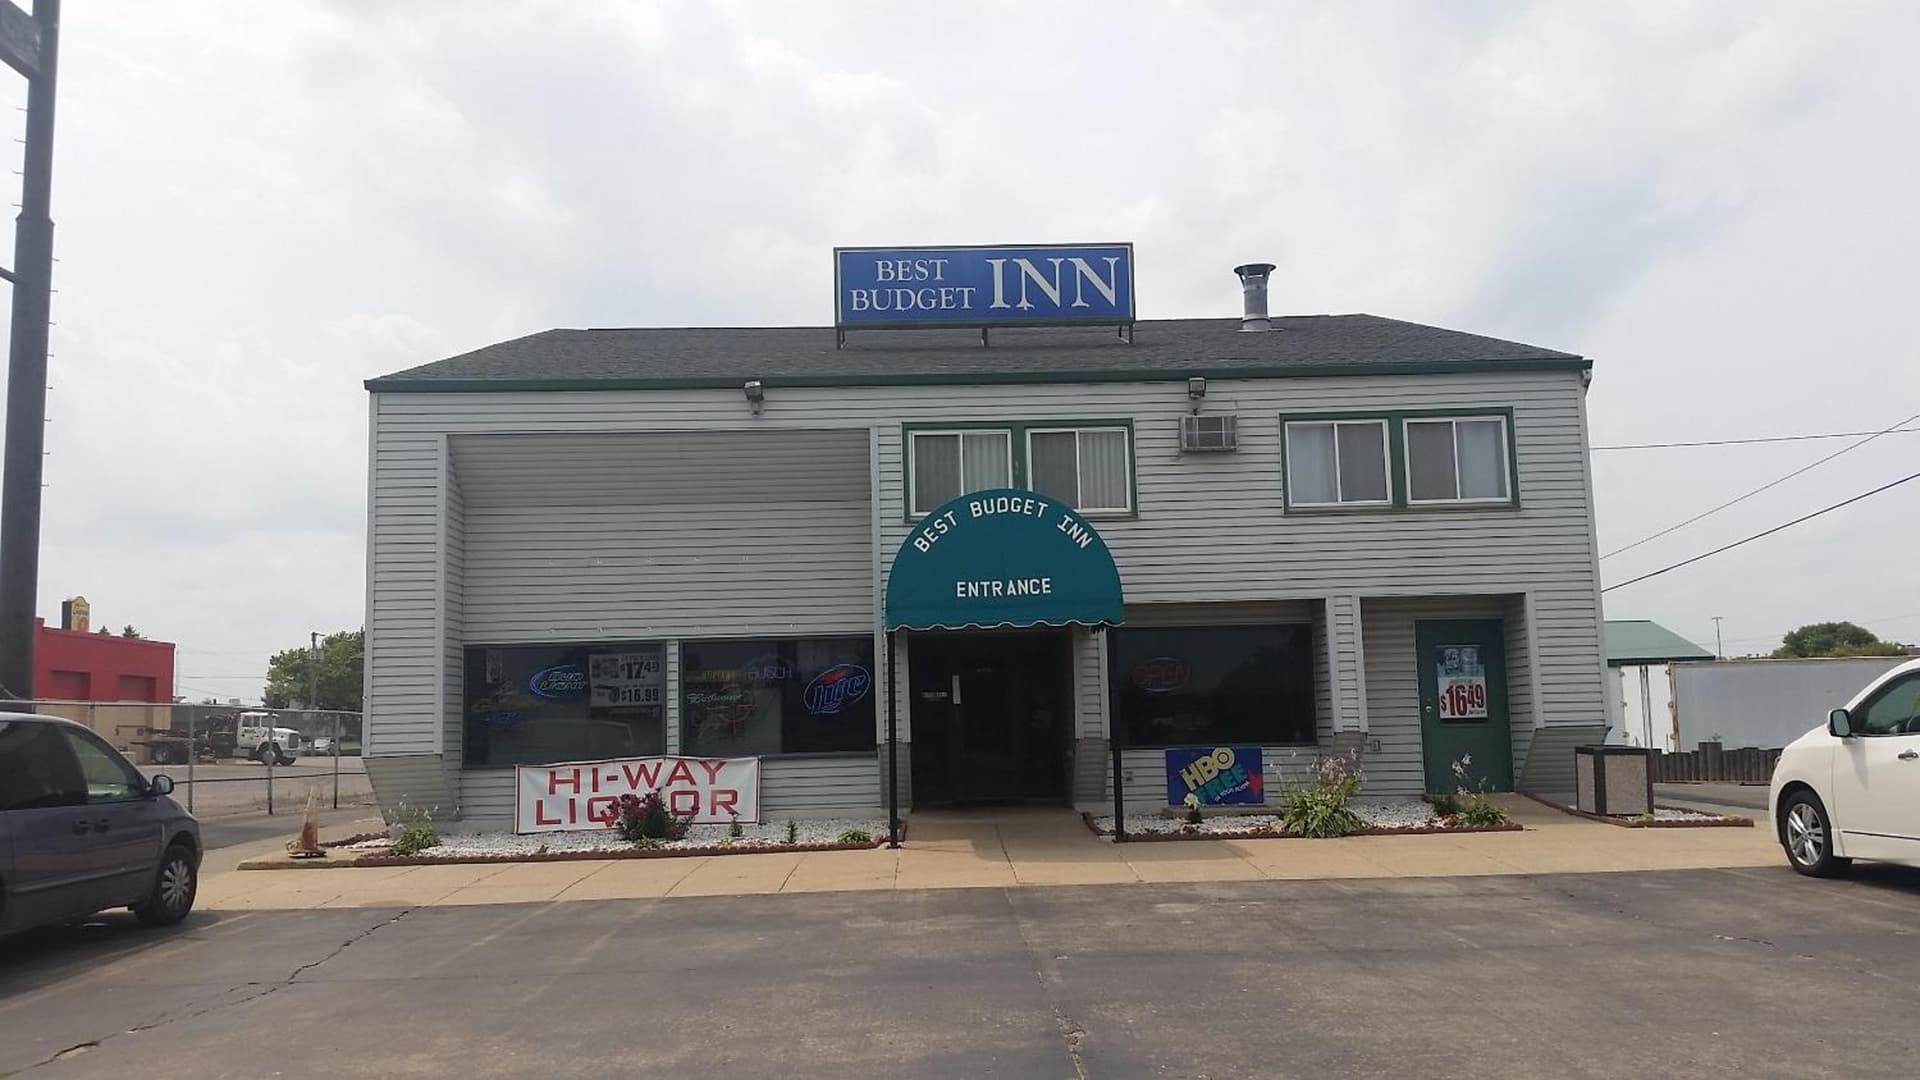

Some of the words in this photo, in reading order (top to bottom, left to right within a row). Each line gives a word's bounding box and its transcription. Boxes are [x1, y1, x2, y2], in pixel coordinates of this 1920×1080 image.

[875, 259, 948, 281] BEST
[986, 256, 1119, 310] INN
[850, 287, 976, 312] BUDGET
[913, 510, 958, 553] BEST
[969, 497, 1049, 518] BUDGET
[1056, 514, 1093, 549] INN
[957, 578, 1052, 597] ENTRANCE
[621, 688, 659, 702] $16.99
[548, 759, 727, 795] HI-WAY
[1179, 747, 1235, 791] HBO
[536, 790, 738, 828] LIQOR
